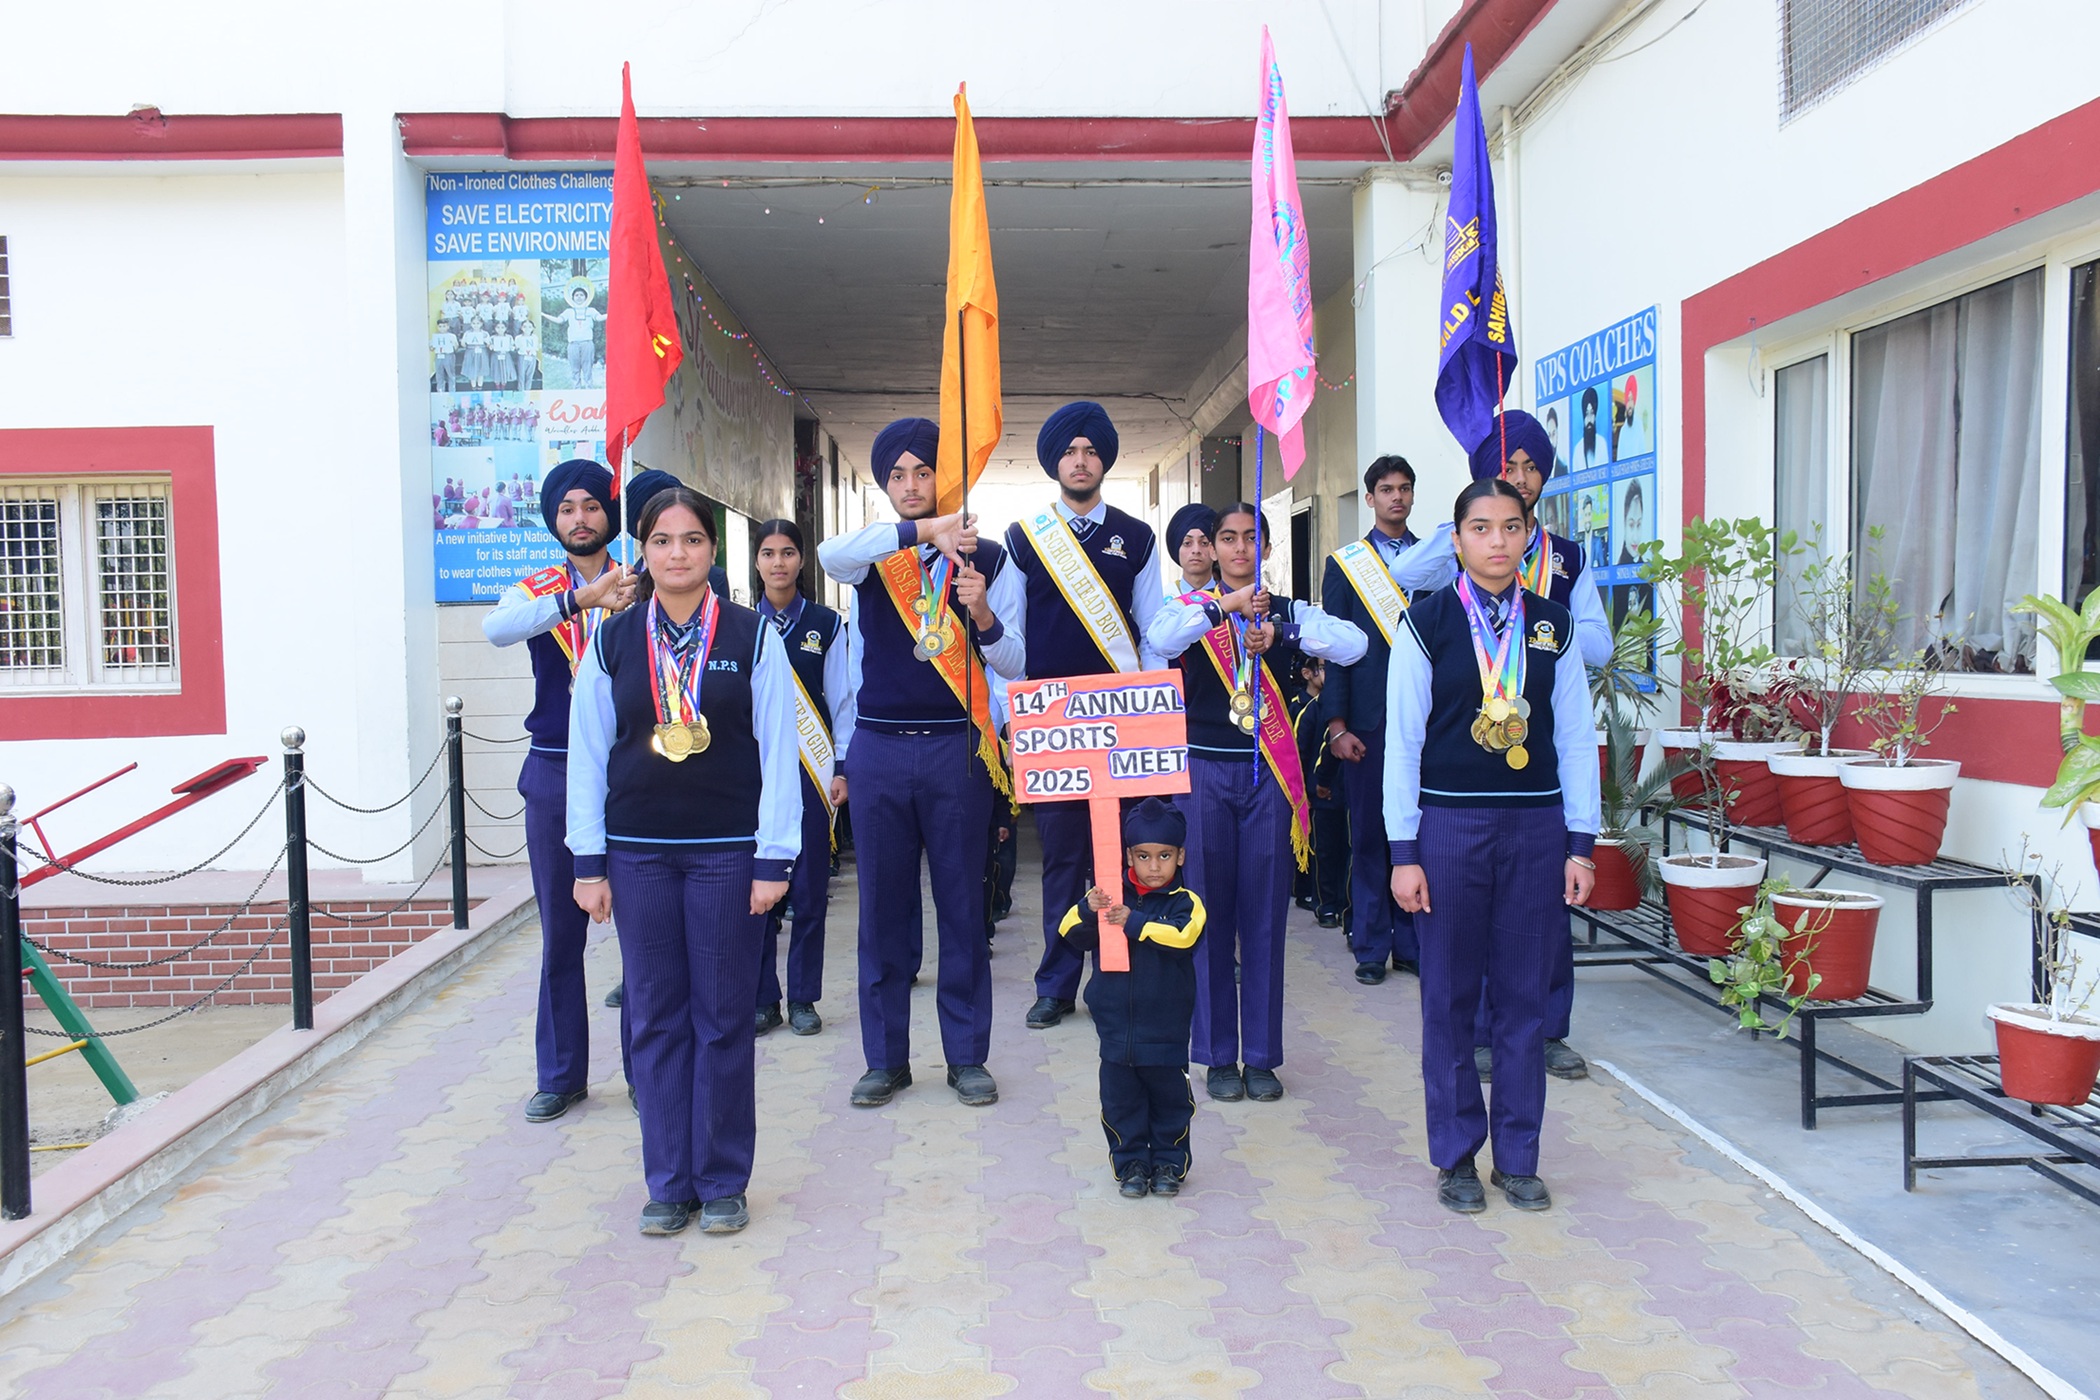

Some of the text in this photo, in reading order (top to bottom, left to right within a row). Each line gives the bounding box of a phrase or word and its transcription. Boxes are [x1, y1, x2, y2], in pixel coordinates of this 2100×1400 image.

[508, 174, 557, 190] Clothes
[560, 173, 614, 192] Challeng
[442, 202, 613, 225] SAVE ELECTRICITY
[434, 231, 610, 253] SAVE ENVIRONMEN
[1536, 310, 1655, 400] NPS COACHES
[436, 531, 560, 546] A new initiative by Nation
[476, 549, 490, 561] for
[492, 549, 503, 561] its
[506, 548, 528, 560] staff
[530, 548, 547, 560] and
[440, 568, 450, 579] to
[452, 569, 474, 579] wear
[476, 566, 511, 578] clothes
[886, 553, 916, 593] OUSE
[1043, 530, 1122, 642] SCHOOL HEAD BOY
[708, 660, 738, 672] N.P.S
[1068, 689, 1184, 717] ANNUAL
[807, 731, 832, 768] GIRL
[1015, 725, 1187, 775] SPORTS MEET
[1026, 769, 1090, 793] 2025
